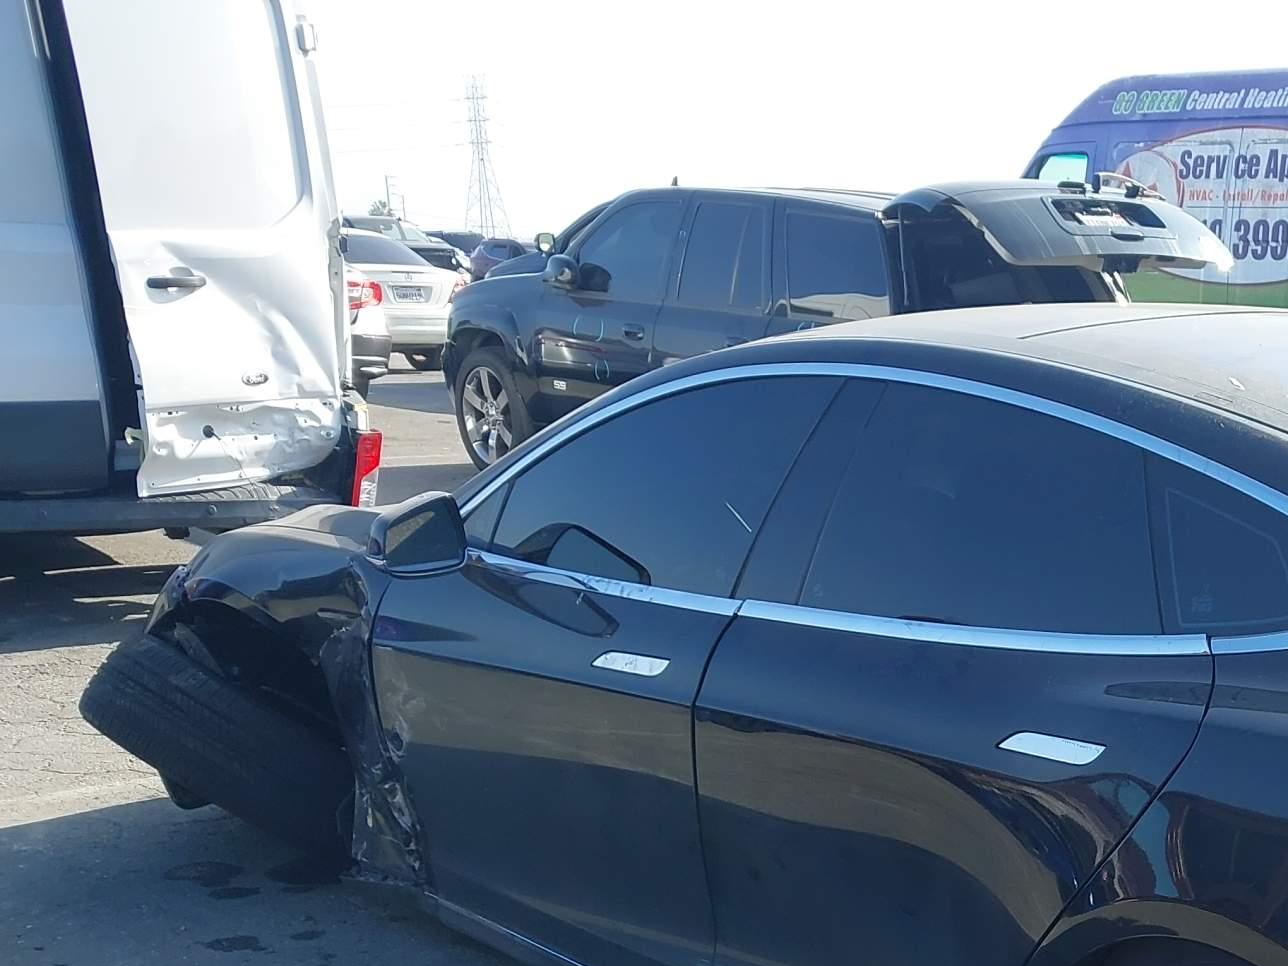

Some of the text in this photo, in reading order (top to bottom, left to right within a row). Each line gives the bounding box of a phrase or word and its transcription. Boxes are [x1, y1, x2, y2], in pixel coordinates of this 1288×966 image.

[1112, 91, 1137, 115] GO
[1136, 89, 1187, 114] GREEN
[1186, 88, 1245, 111] Central
[1179, 150, 1261, 179] Servce
